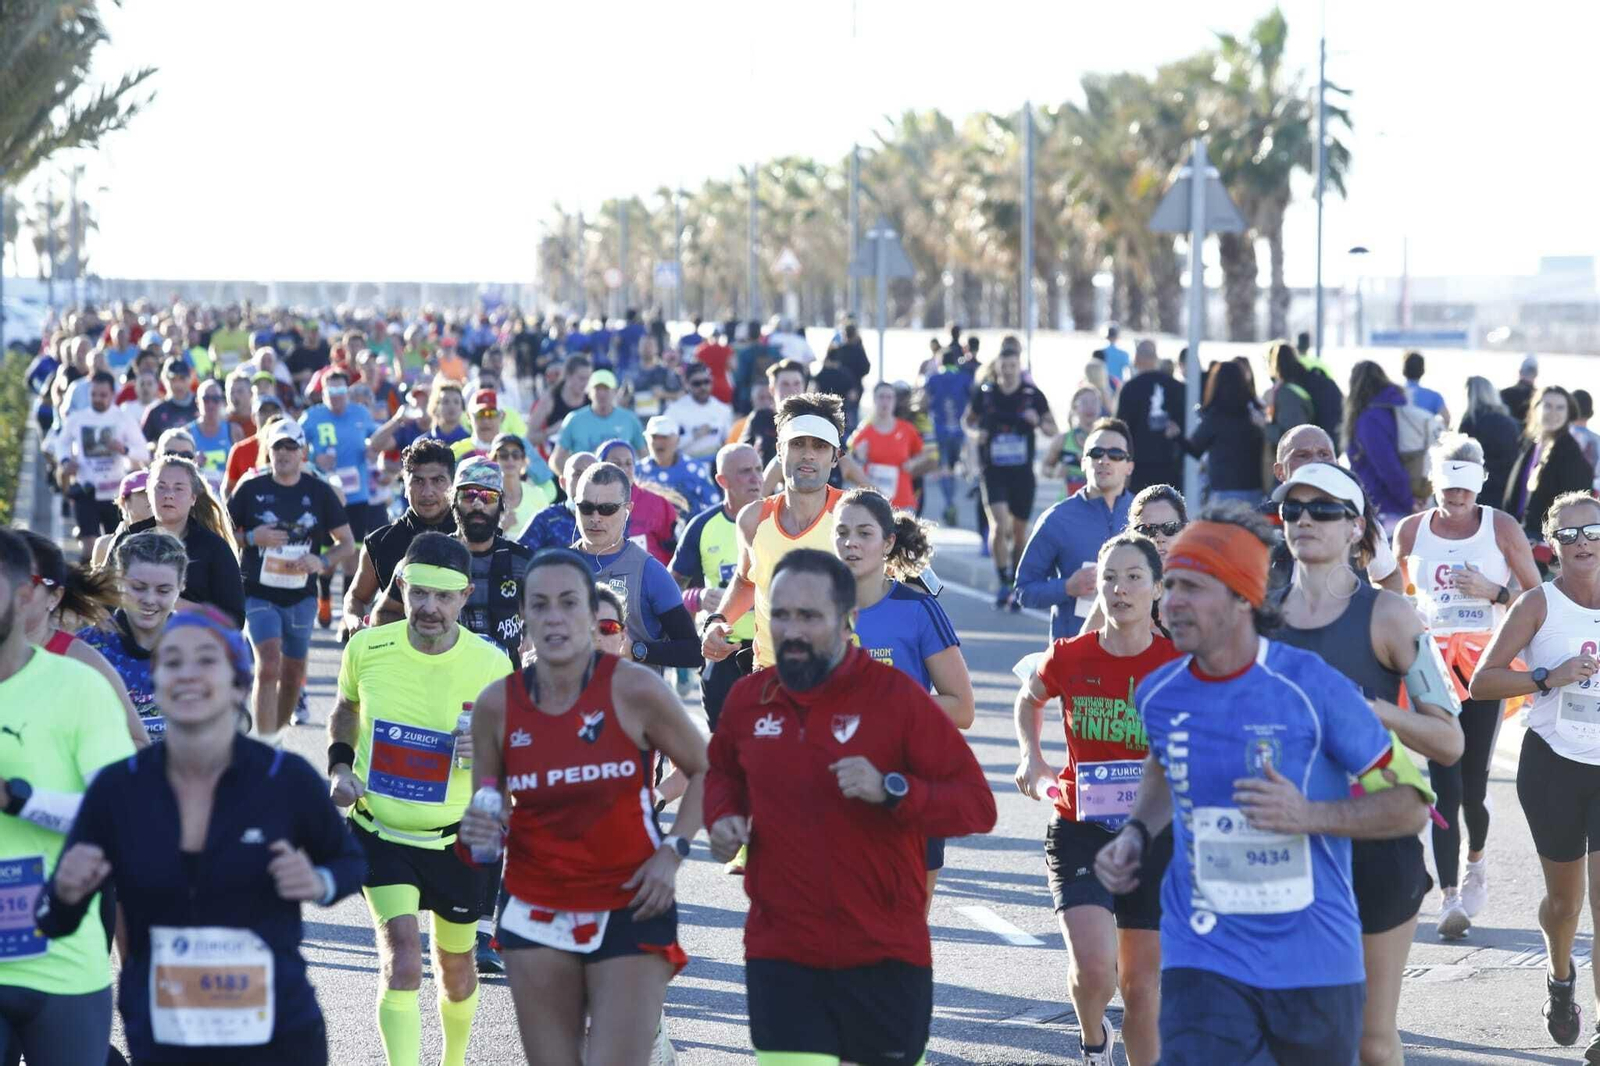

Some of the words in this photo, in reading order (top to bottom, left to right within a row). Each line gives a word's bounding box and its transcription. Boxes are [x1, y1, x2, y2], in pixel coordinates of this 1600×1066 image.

[1458, 609, 1484, 619] 8749
[403, 730, 438, 745] ZURICH
[546, 760, 636, 787] PEDRO
[1246, 848, 1291, 866] 9434
